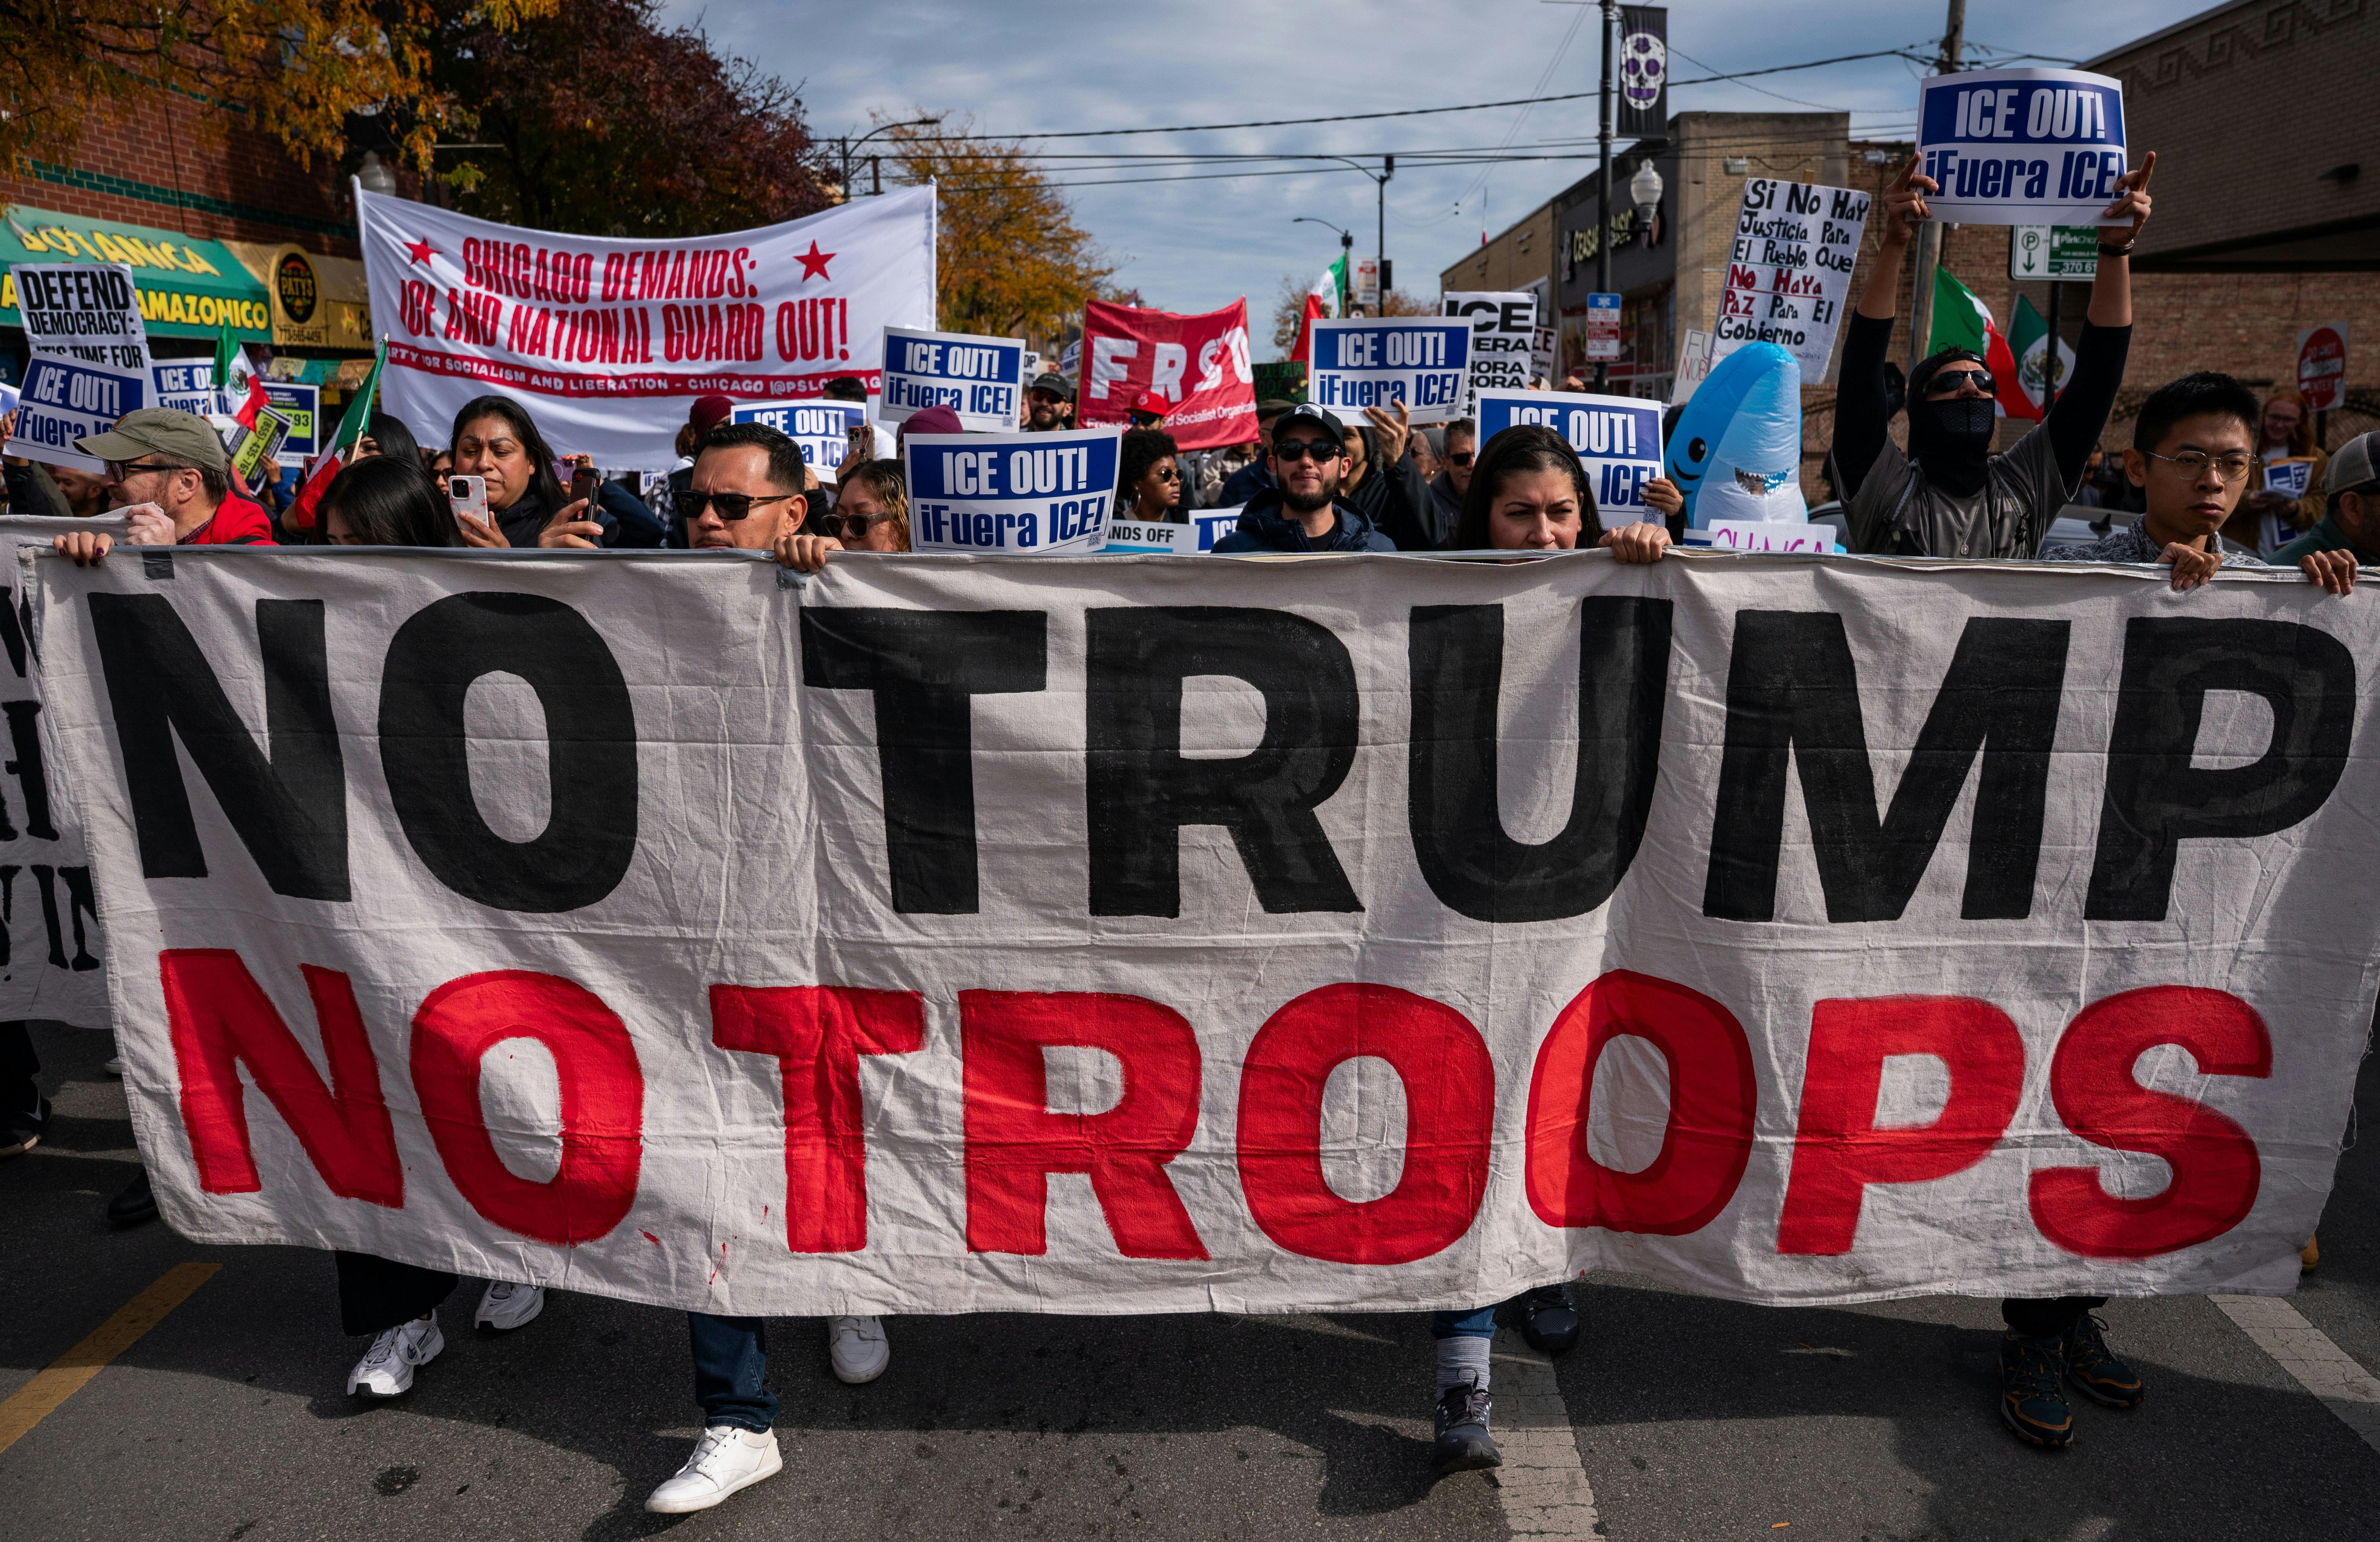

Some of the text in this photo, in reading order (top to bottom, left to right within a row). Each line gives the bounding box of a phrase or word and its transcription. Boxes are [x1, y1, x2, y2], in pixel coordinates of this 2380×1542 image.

[1955, 88, 2105, 139] ICE OUT!
[1923, 150, 2126, 199] ¡Fuera ICE!
[1787, 184, 1820, 214] No
[1821, 221, 1850, 245] Para
[462, 237, 758, 304] CHICAGO DEMANDS:
[1730, 264, 1755, 289] No
[1816, 247, 1853, 273] Que
[2062, 262, 2083, 273] 370
[19, 270, 131, 311] DEFEND
[1769, 295, 1798, 319] Para
[27, 311, 137, 336] DEMOCRACY:
[400, 279, 850, 365] ICE AND NATIONAL GUARD OUT!
[1446, 300, 1533, 333] ICE
[1717, 317, 1806, 346] Gobierno
[112, 345, 144, 369] FOR
[905, 342, 1000, 379] ICE OUT!
[1338, 332, 1446, 367] ICE OUT!
[1472, 337, 1530, 352] ERA
[387, 346, 419, 363] ARTY
[445, 357, 526, 382] SOCIALISM
[531, 375, 565, 391] AND
[569, 377, 669, 392] LIBERATION
[688, 378, 764, 393] CHICAGO
[1023, 355, 1036, 368] OP
[1089, 325, 1253, 403] FRSO
[1470, 361, 1525, 374] HORA
[34, 366, 120, 416] ICE OUT!
[160, 367, 217, 392] ICE OU
[889, 376, 1012, 415] ¡Fuera ICE!
[1319, 374, 1406, 407] ¡Fuera
[1415, 374, 1460, 406] ICE!
[1468, 376, 1525, 389] HORA
[158, 396, 213, 415] Fuera
[1175, 408, 1217, 426] Socialist
[13, 405, 87, 448] ¡Fuera
[795, 410, 846, 435] OUT!
[1568, 410, 1637, 455] OUT!
[943, 447, 1087, 495] ICE OUT!
[921, 496, 1106, 547] ¡Fuera ICE!
[1147, 528, 1175, 543] OFF
[88, 591, 637, 913] NO
[802, 594, 2357, 923] TRUMP
[159, 947, 2274, 1265] NO TROOPS
